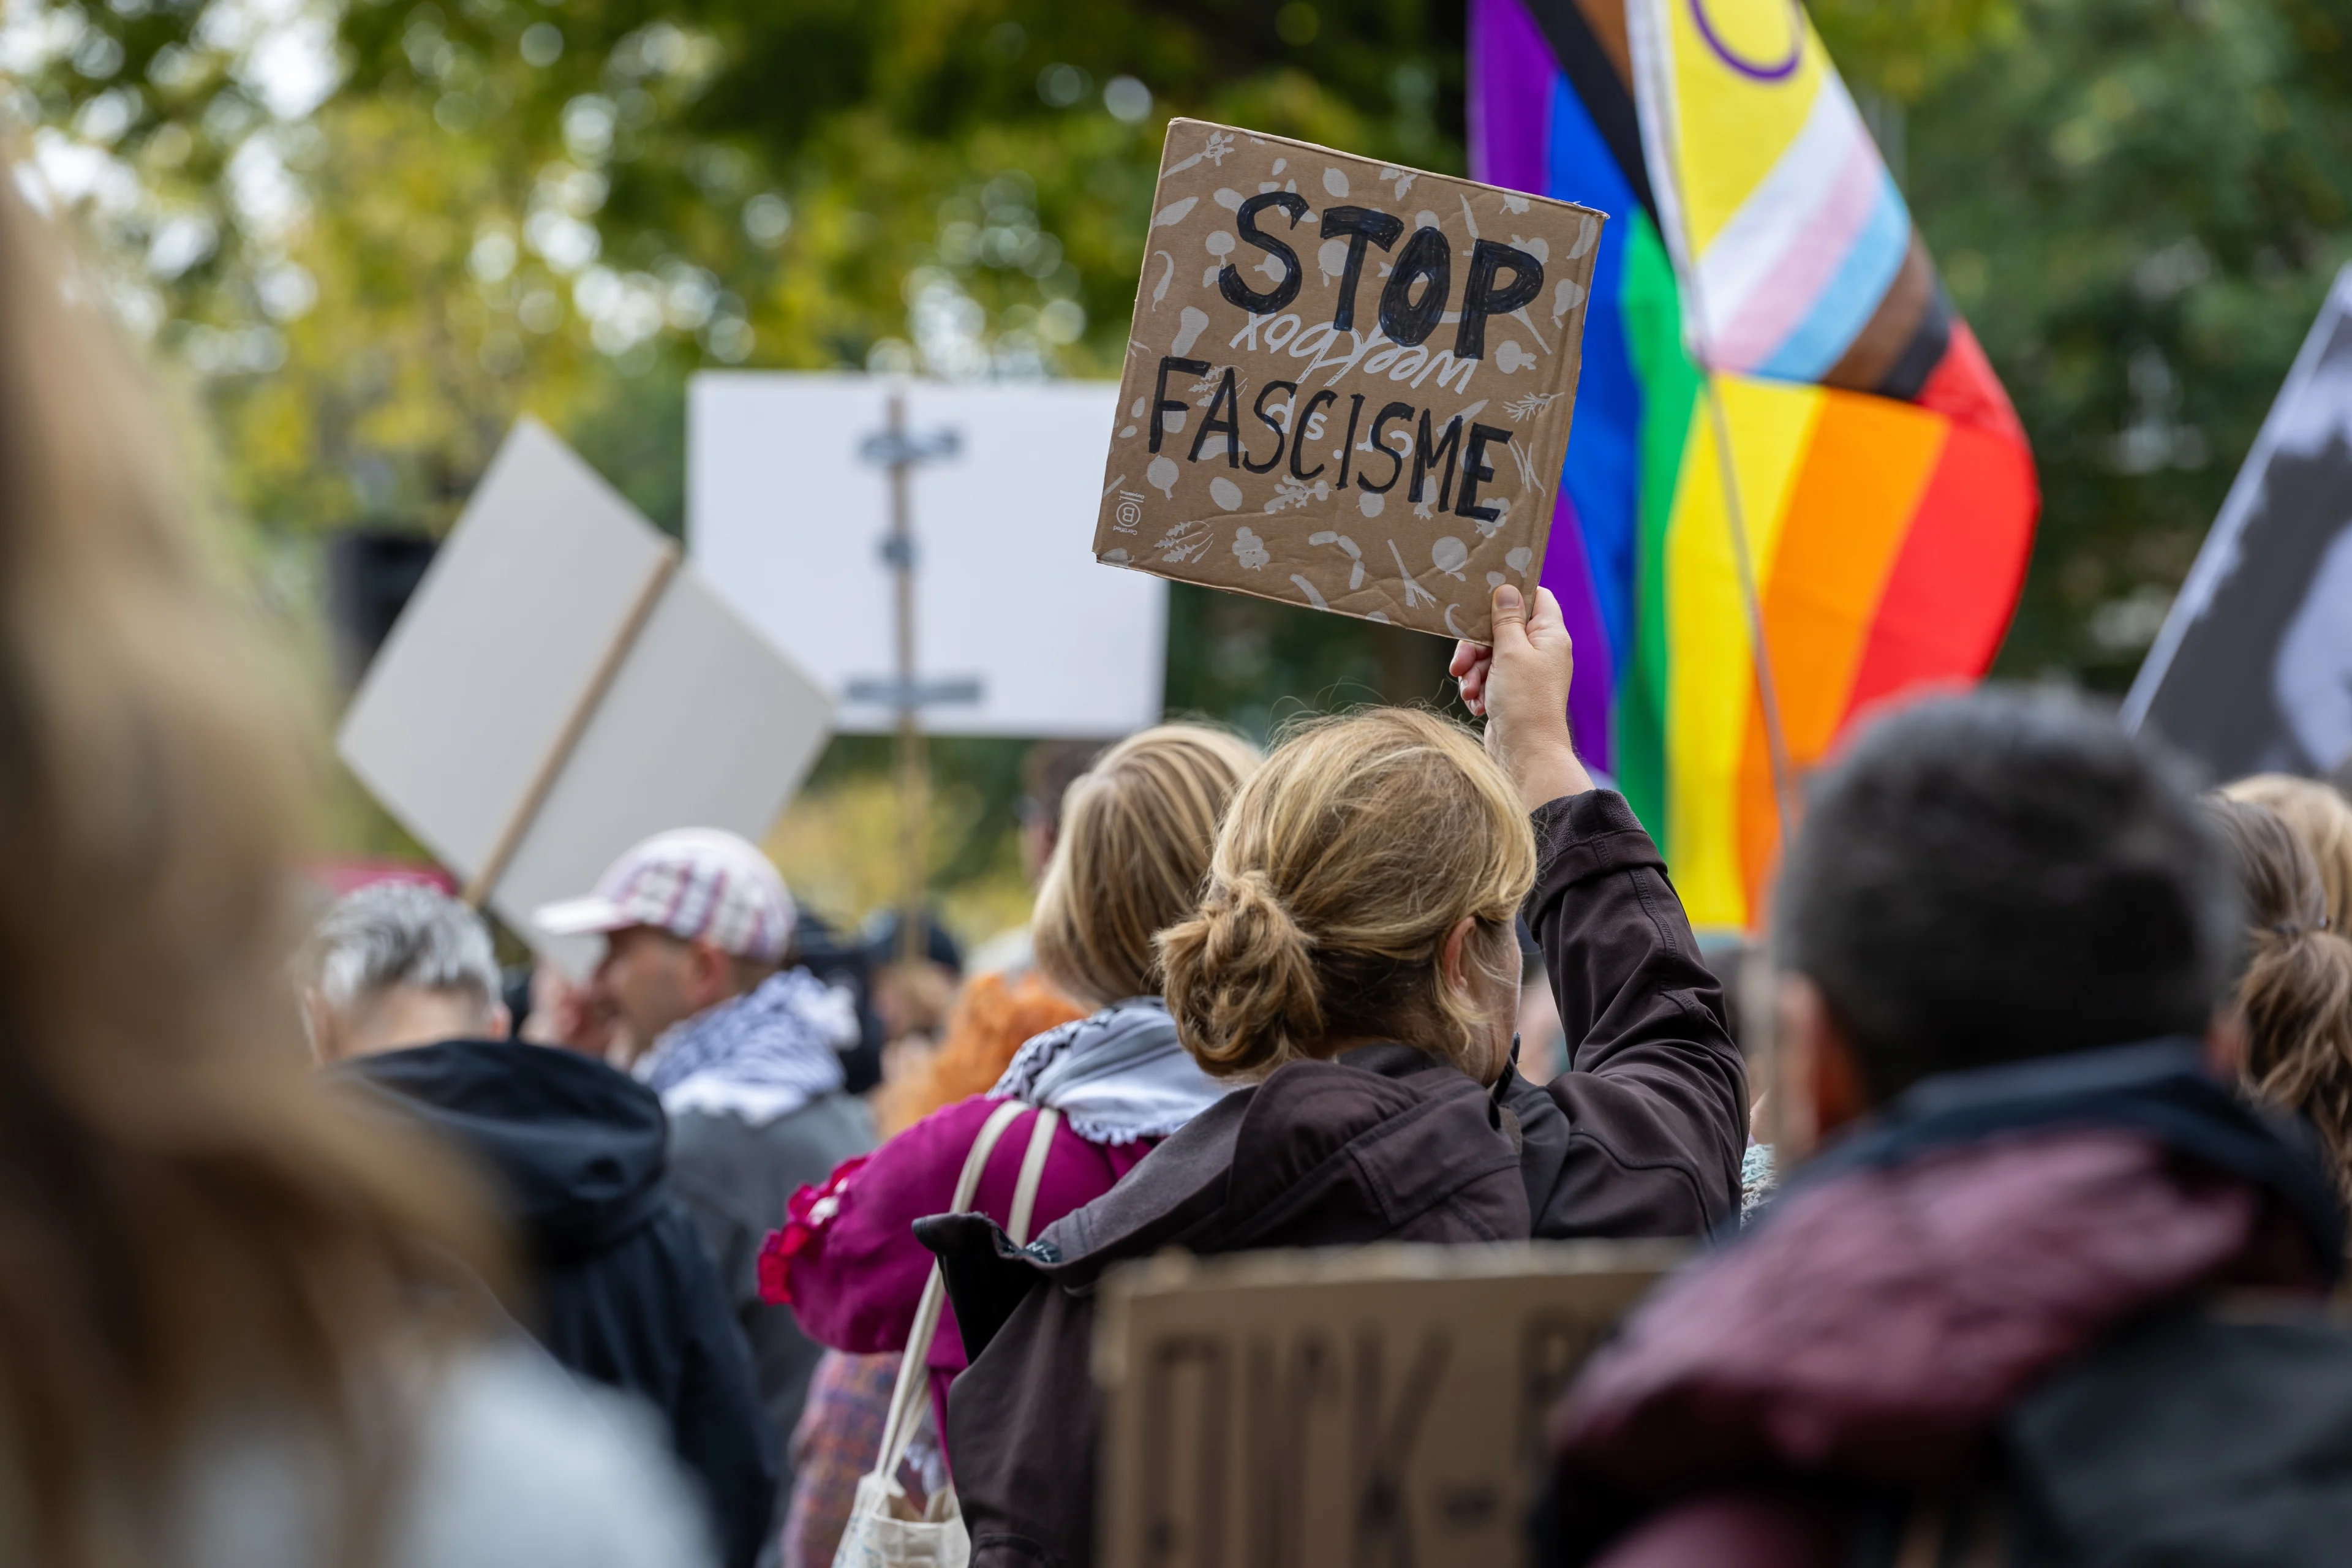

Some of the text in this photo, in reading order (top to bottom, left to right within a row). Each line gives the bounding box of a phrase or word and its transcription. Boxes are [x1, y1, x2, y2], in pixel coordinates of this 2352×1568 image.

[1219, 191, 1544, 360] STOP
[1229, 311, 1479, 394] weekbox
[1148, 356, 1513, 522] FASCISME
[1265, 395, 1414, 459] crsp
[1113, 526, 1137, 535] Certified
